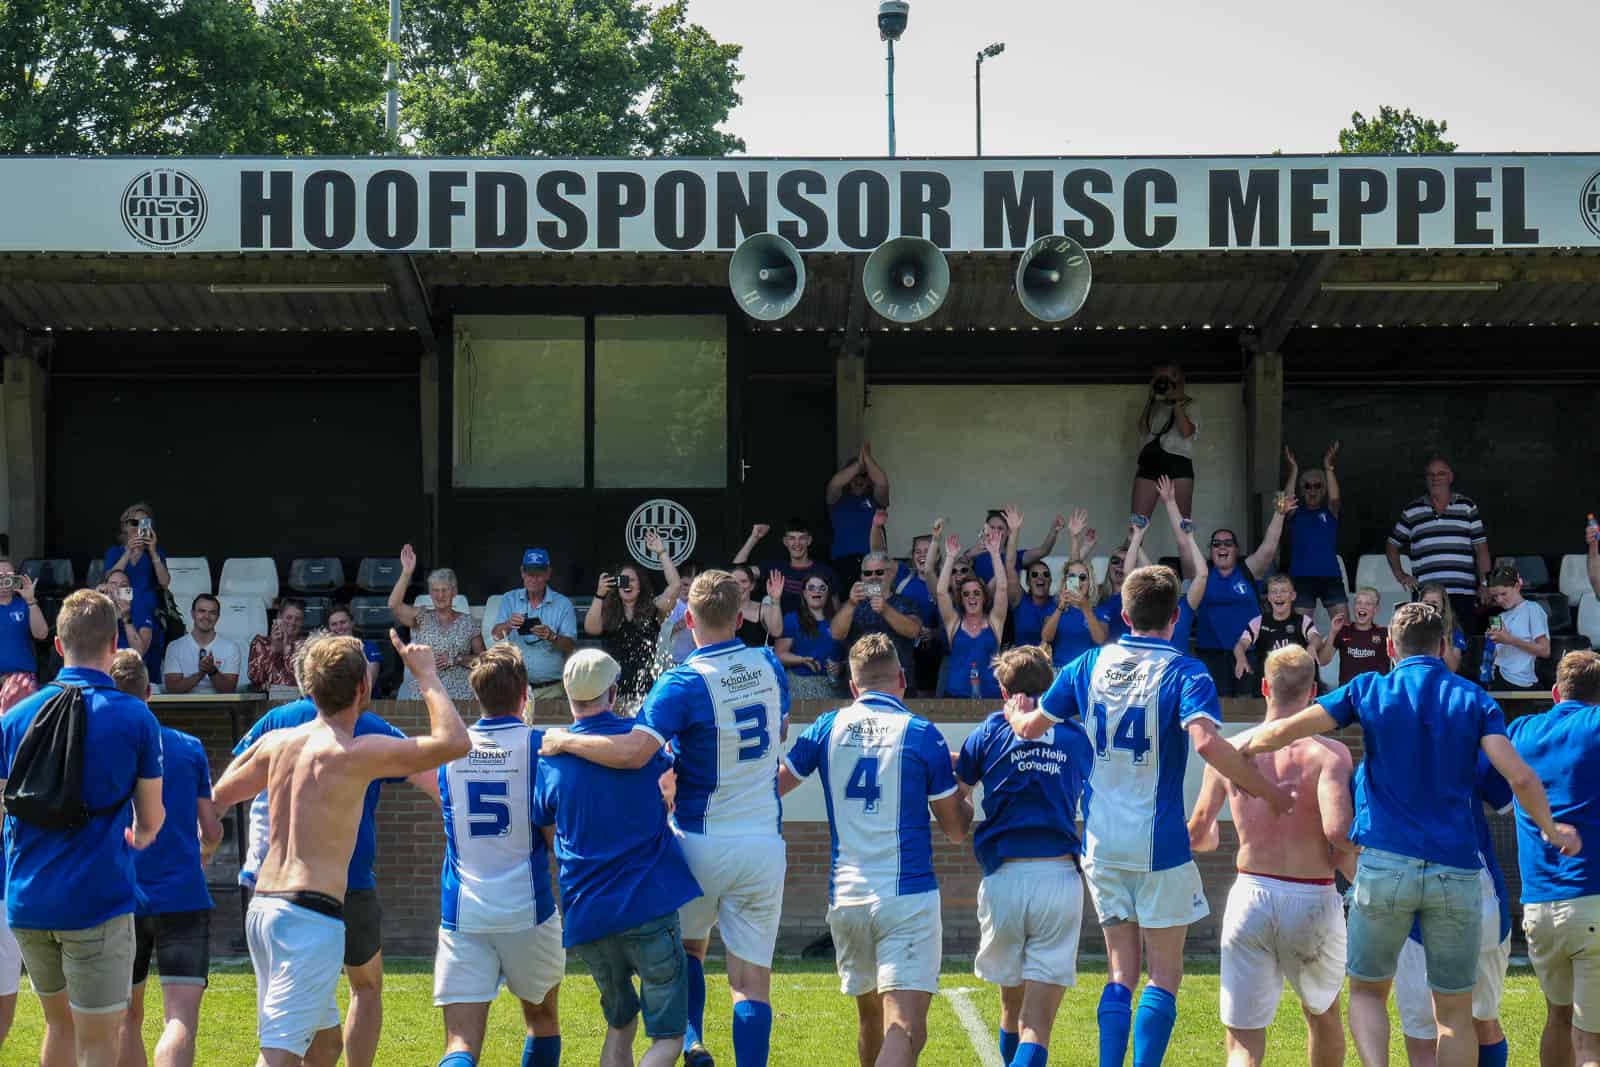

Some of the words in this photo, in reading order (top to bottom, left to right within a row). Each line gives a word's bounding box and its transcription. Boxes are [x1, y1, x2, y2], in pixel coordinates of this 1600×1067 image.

[133, 198, 194, 216] MSC
[240, 169, 951, 250] HOOFDSPONSOR
[983, 168, 1178, 250] MSC
[1208, 166, 1539, 248] MEPPEL
[720, 669, 763, 688] Schokker
[468, 749, 512, 759] chokker
[732, 702, 771, 763] 3
[1092, 701, 1152, 766] 14
[465, 780, 512, 838] 5
[844, 755, 883, 815] 4
